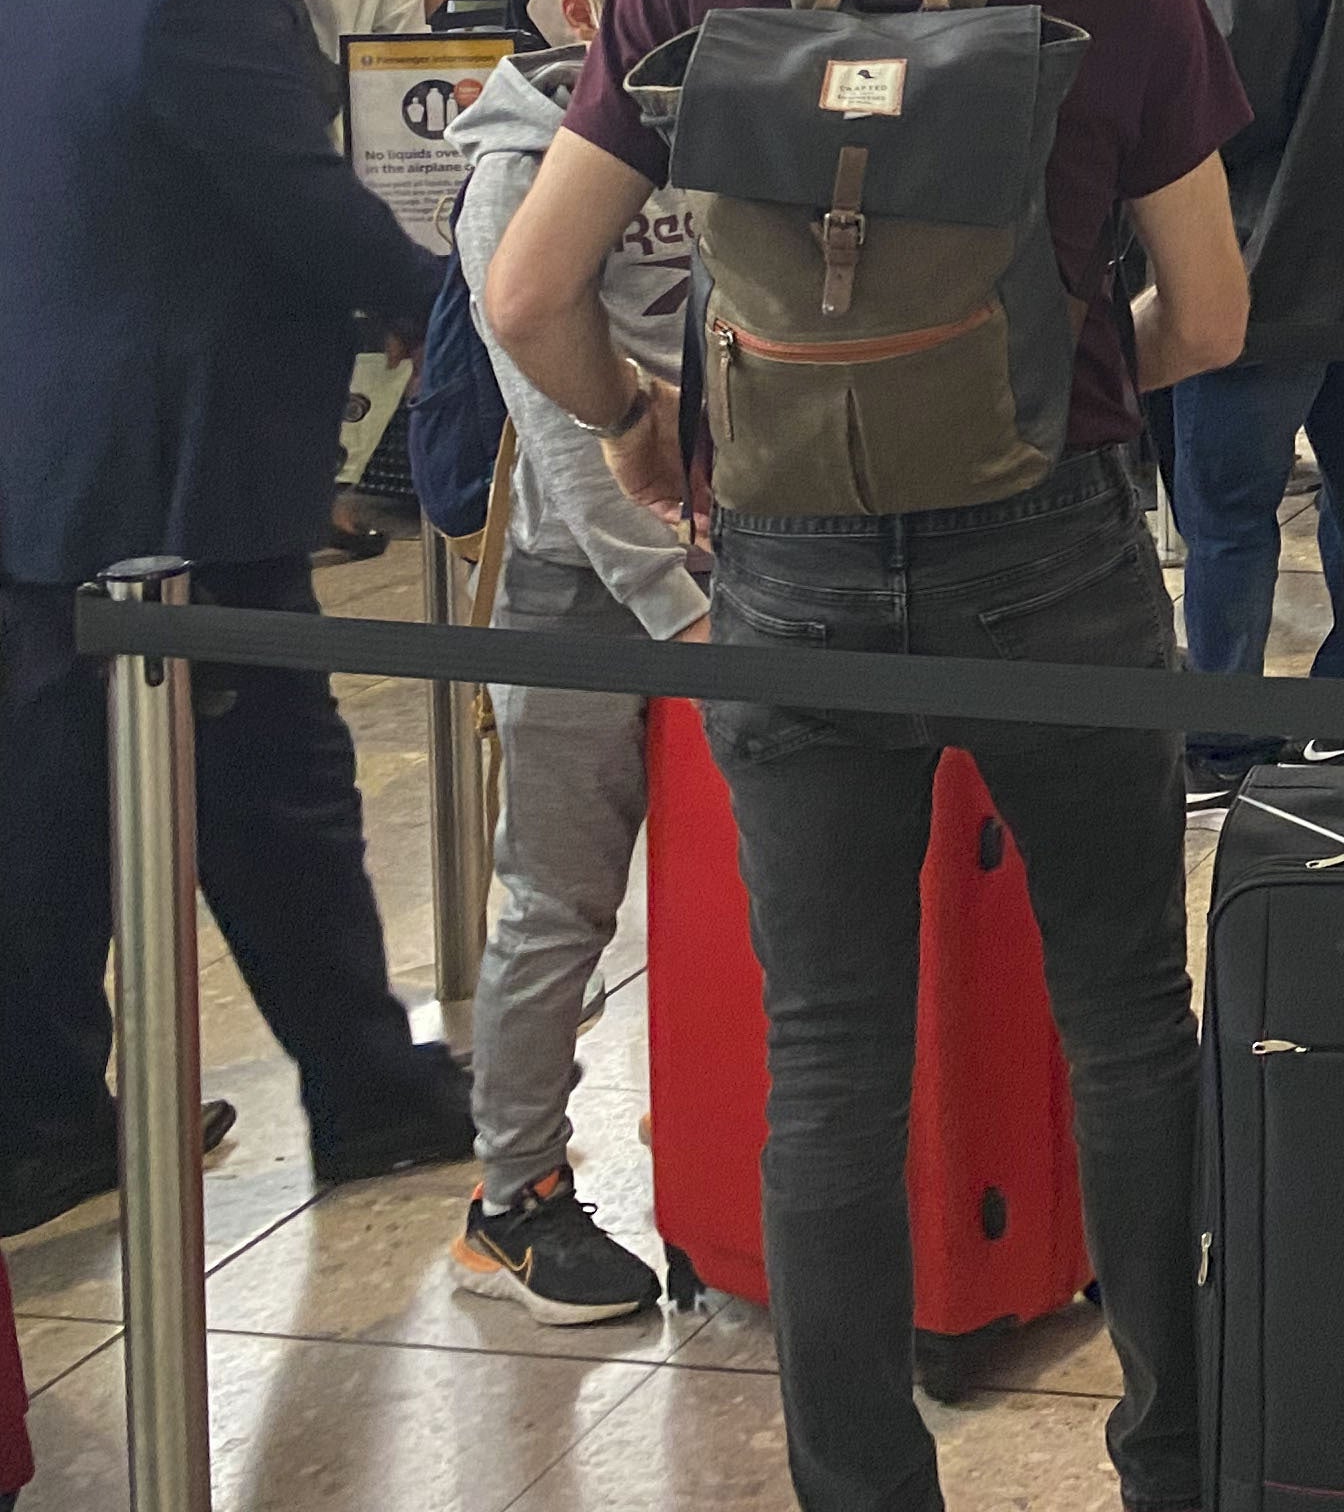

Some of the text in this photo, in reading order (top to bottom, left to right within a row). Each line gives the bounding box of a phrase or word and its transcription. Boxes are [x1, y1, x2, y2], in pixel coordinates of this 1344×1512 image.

[365, 150, 385, 161] No
[387, 149, 433, 162] liquids
[382, 161, 404, 173] the
[407, 162, 465, 174] airplane
